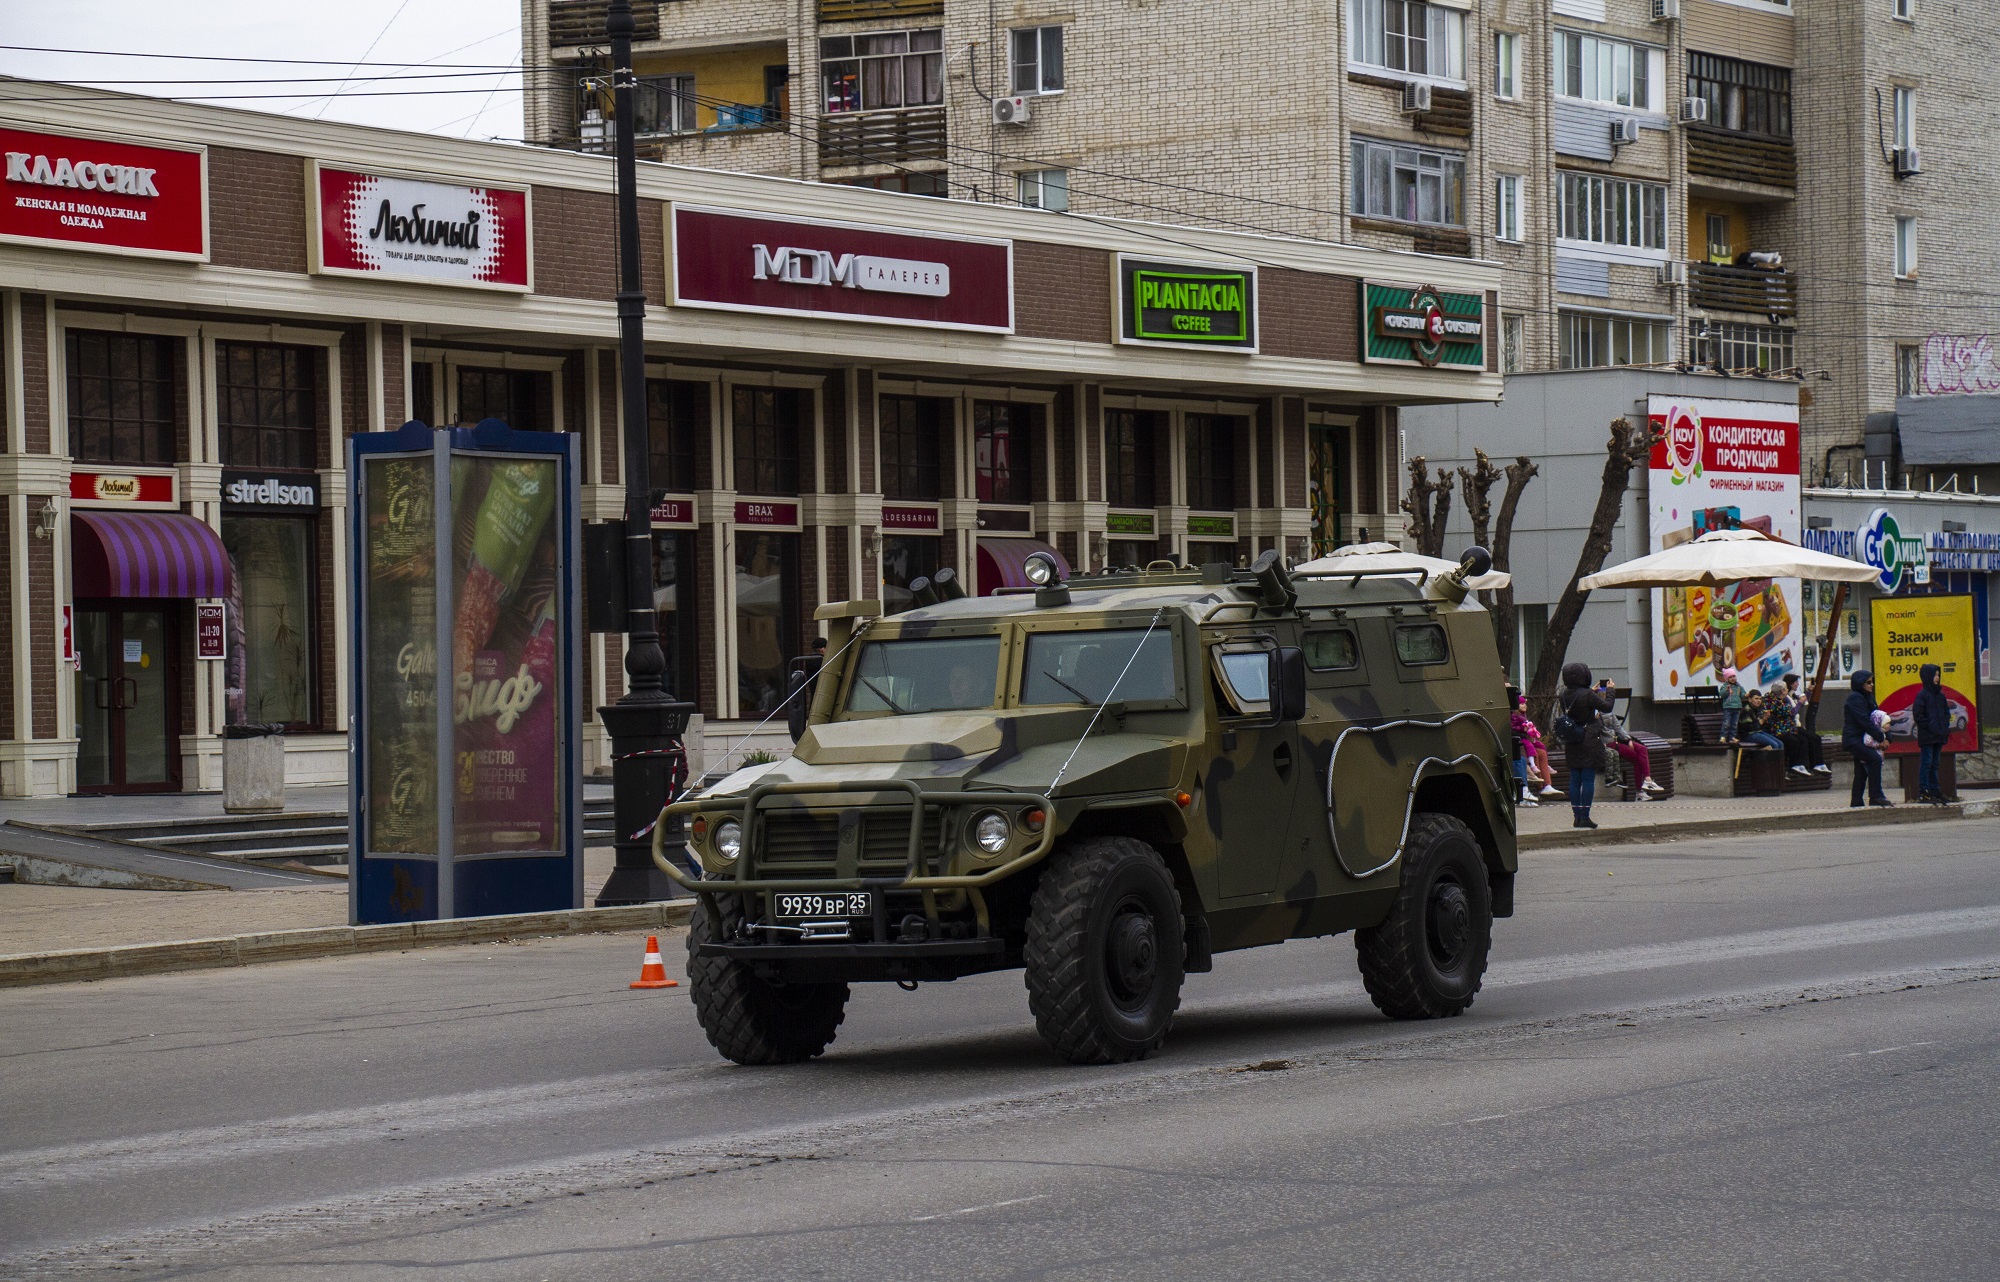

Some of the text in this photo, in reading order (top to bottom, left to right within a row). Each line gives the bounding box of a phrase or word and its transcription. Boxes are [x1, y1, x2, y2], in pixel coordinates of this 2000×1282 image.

[5, 152, 159, 197] КЛАССИК
[15, 197, 147, 221] ЖЕНСКАЯ И МОЛОДЕЖНАЯ
[60, 215, 104, 229] ОДЕЖДА
[369, 199, 480, 249] Любимый
[752, 243, 856, 288] MDM
[868, 266, 941, 285] ГАЛЕРЕЯ
[1142, 281, 1240, 311] PLANTACIA
[1172, 314, 1211, 332] COFFEE
[1432, 316, 1444, 335] &
[1675, 428, 1695, 442] KDV
[1709, 426, 1785, 447] КОНДИТЕРСКАЯ
[1717, 448, 1778, 470] ПРОДУКЦИЯ
[100, 480, 134, 492] Любимый
[226, 479, 314, 506] strellson
[1709, 477, 1785, 492] ФИРМЕННЫЙ МАГАЗИН
[748, 505, 773, 516] BRAX
[1932, 532, 1944, 548] МЫ
[199, 608, 221, 617] MDM
[1888, 631, 1943, 643] Закажи
[1888, 646, 1929, 657] такси
[782, 896, 822, 915] 9939
[849, 895, 866, 909] 25
